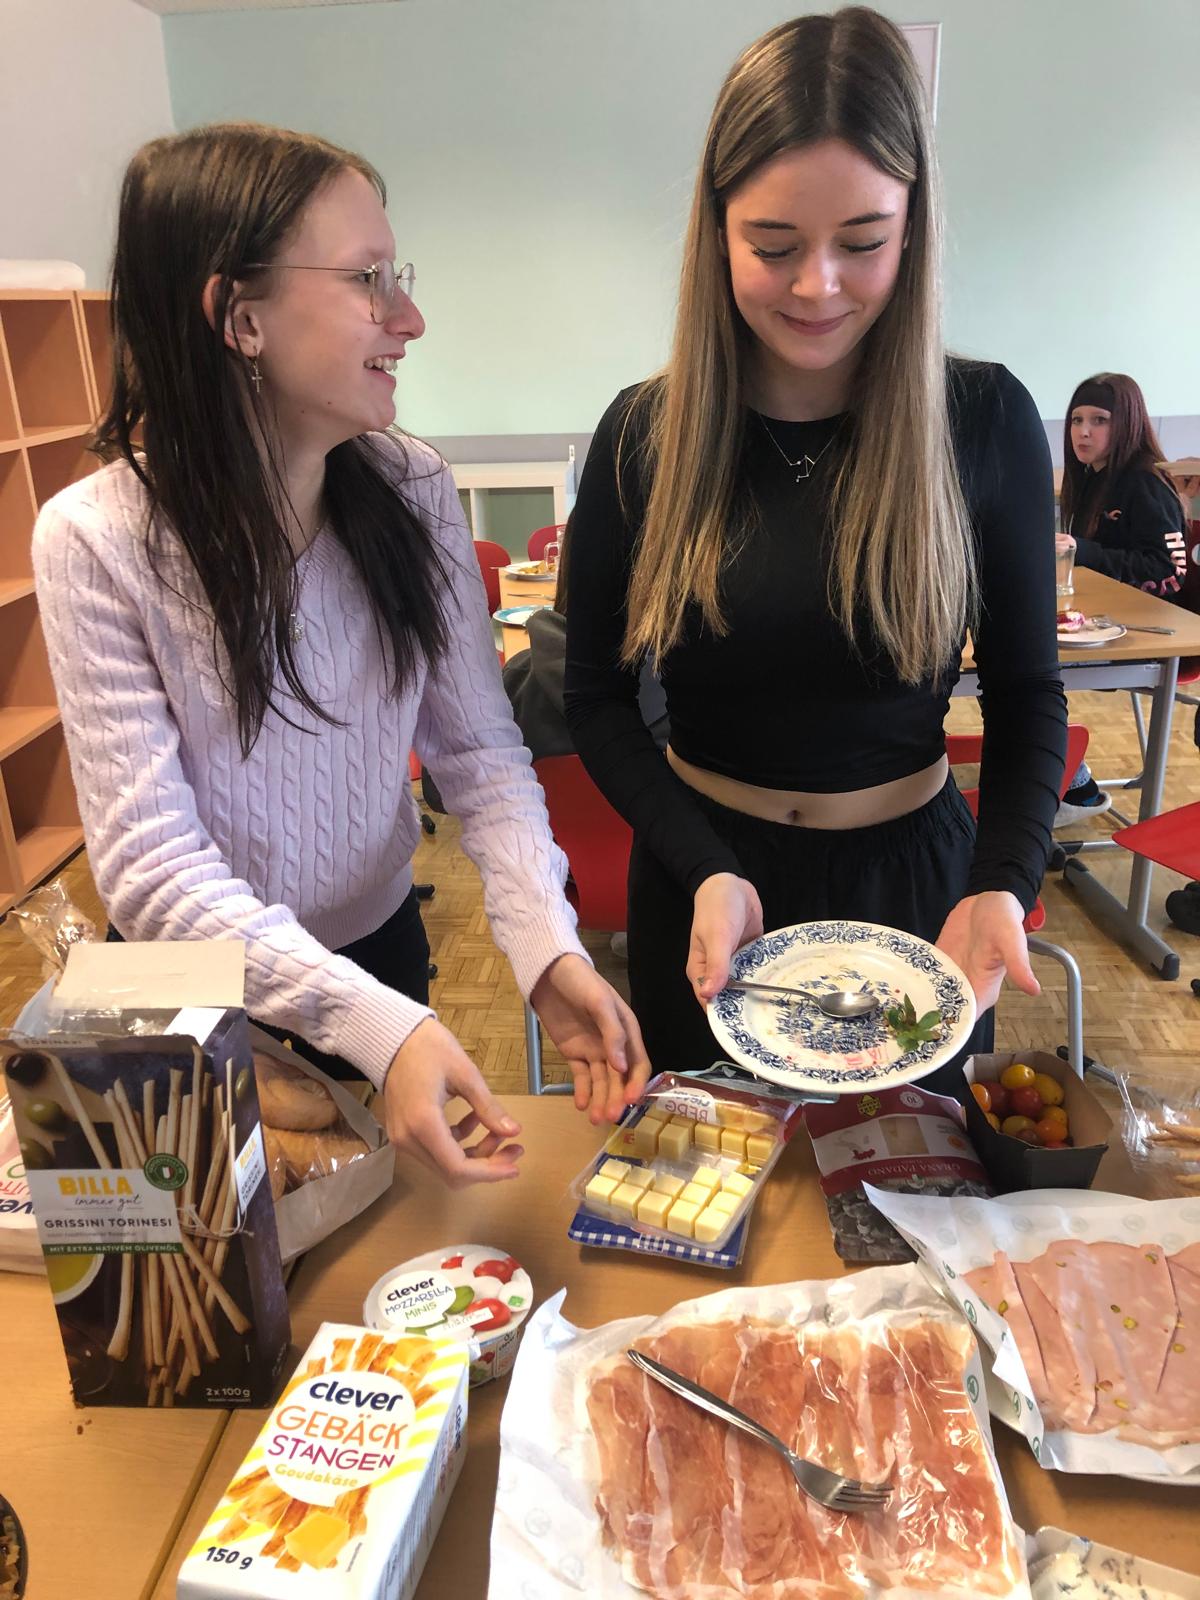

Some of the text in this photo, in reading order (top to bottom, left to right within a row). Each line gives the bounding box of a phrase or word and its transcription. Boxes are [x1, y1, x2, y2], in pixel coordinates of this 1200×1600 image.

[57, 1176, 134, 1196] BILLA
[117, 1194, 142, 1211] gut
[44, 1218, 173, 1229] GRISSINI TORINESI
[384, 1285, 453, 1316] MOZZARELLA
[386, 1277, 435, 1302] clever
[404, 1301, 437, 1320] MINIS
[309, 1381, 404, 1412] clever
[276, 1405, 408, 1450] GEBÄCK
[267, 1434, 396, 1471] STANGEN
[274, 1463, 358, 1487] Goudakäse
[206, 1546, 253, 1570] 150 g
